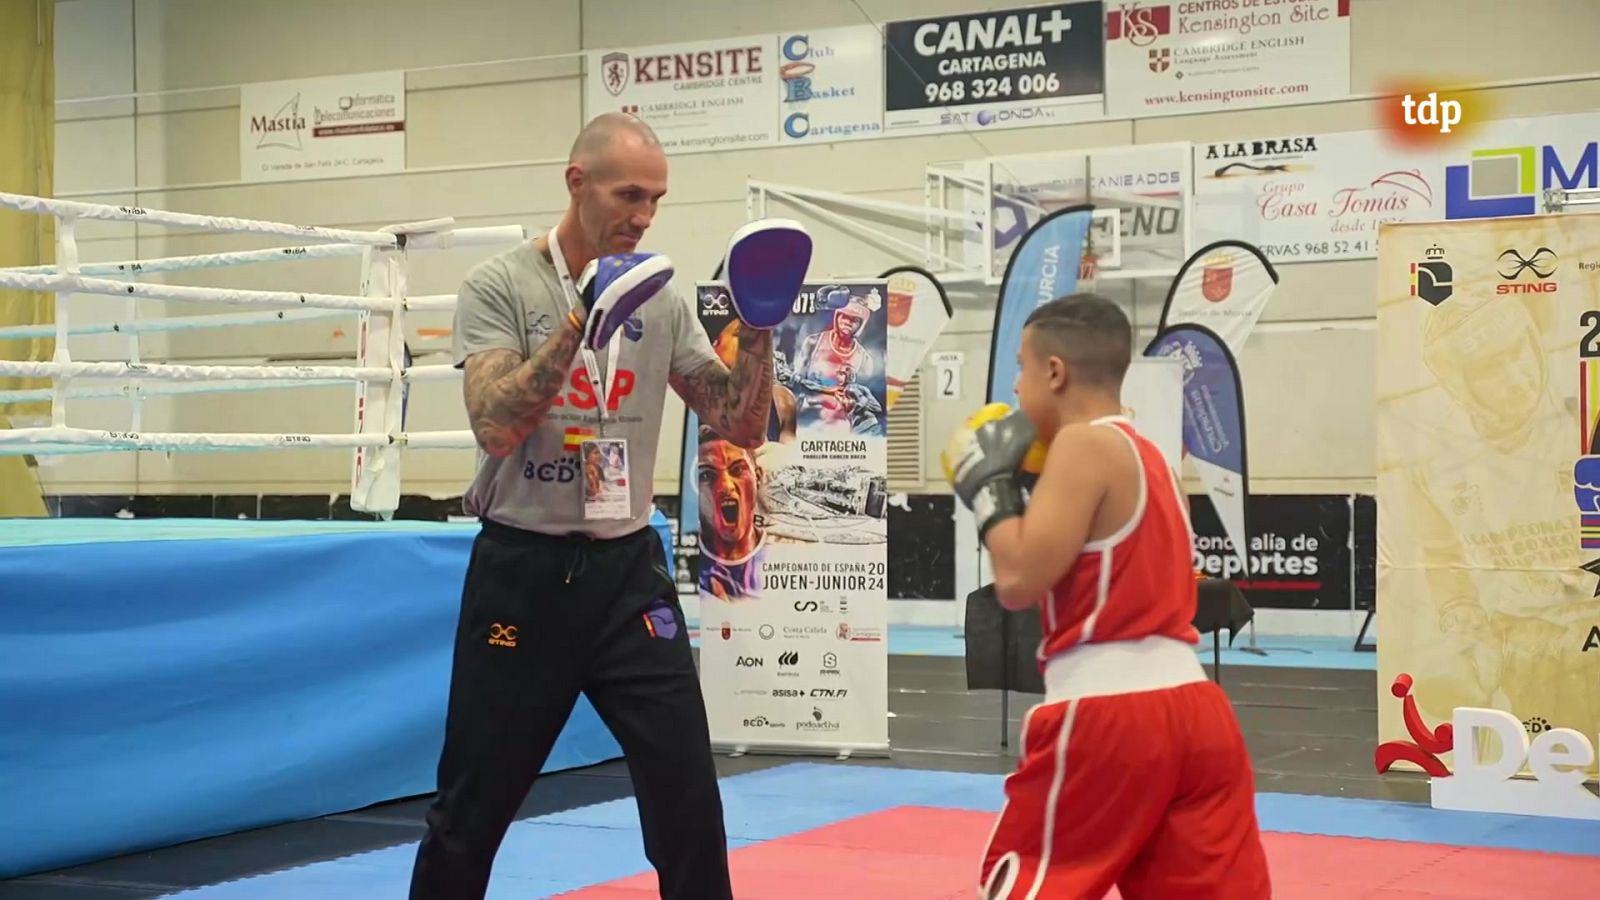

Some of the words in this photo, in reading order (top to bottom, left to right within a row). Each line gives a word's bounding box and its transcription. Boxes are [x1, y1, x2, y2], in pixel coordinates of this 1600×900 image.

[1178, 0, 1239, 14] CENTROS
[1178, 11, 1282, 35] Kensington
[1290, 4, 1330, 24] Site
[913, 9, 1072, 57] CANAL+
[783, 35, 835, 61] Club
[1173, 41, 1246, 57] CAMBRIDGE
[1250, 36, 1305, 49] ENGLISH
[633, 46, 763, 85] KENSITE
[938, 51, 1046, 76] CARTAGENA
[673, 79, 725, 91] CAMBRIDGE
[728, 76, 763, 86] CENTRE
[782, 76, 855, 103] Basket
[925, 80, 965, 102] 968
[971, 77, 1012, 99] 324
[1018, 73, 1060, 95] 006
[1144, 83, 1309, 106] www.kensingtonsite.com
[250, 112, 306, 134] Mastia
[783, 112, 880, 139] Cartagena
[940, 111, 971, 125] SAT
[1206, 145, 1219, 159] A
[1223, 143, 1247, 158] LA
[1251, 137, 1318, 156] BRASA
[1263, 181, 1305, 196] Grupo
[1256, 194, 1318, 221] Casa
[1328, 187, 1409, 218] Tomás
[1331, 219, 1366, 233] desde
[1258, 243, 1300, 256] ERVAS
[1305, 242, 1329, 255] 968
[1333, 241, 1349, 254] 52
[1354, 240, 1368, 251] 41
[1037, 245, 1061, 307] URCIA
[1496, 282, 1558, 295] STING
[552, 367, 635, 411] SP
[943, 368, 954, 396] 2
[801, 440, 867, 453] CARTAGENA
[524, 460, 575, 483] BCD
[1291, 533, 1319, 551] de
[762, 562, 819, 573] CAMPEONATO
[820, 562, 831, 573] DE
[834, 561, 866, 573] ESPAÑA
[868, 562, 885, 576] 20
[763, 574, 866, 590] JOVEN-JUNIOR
[868, 578, 884, 590] 24
[772, 689, 798, 698] asisa
[809, 688, 848, 698] CTN.FI
[796, 720, 840, 731] podoactiva
[1453, 707, 1600, 786] De
